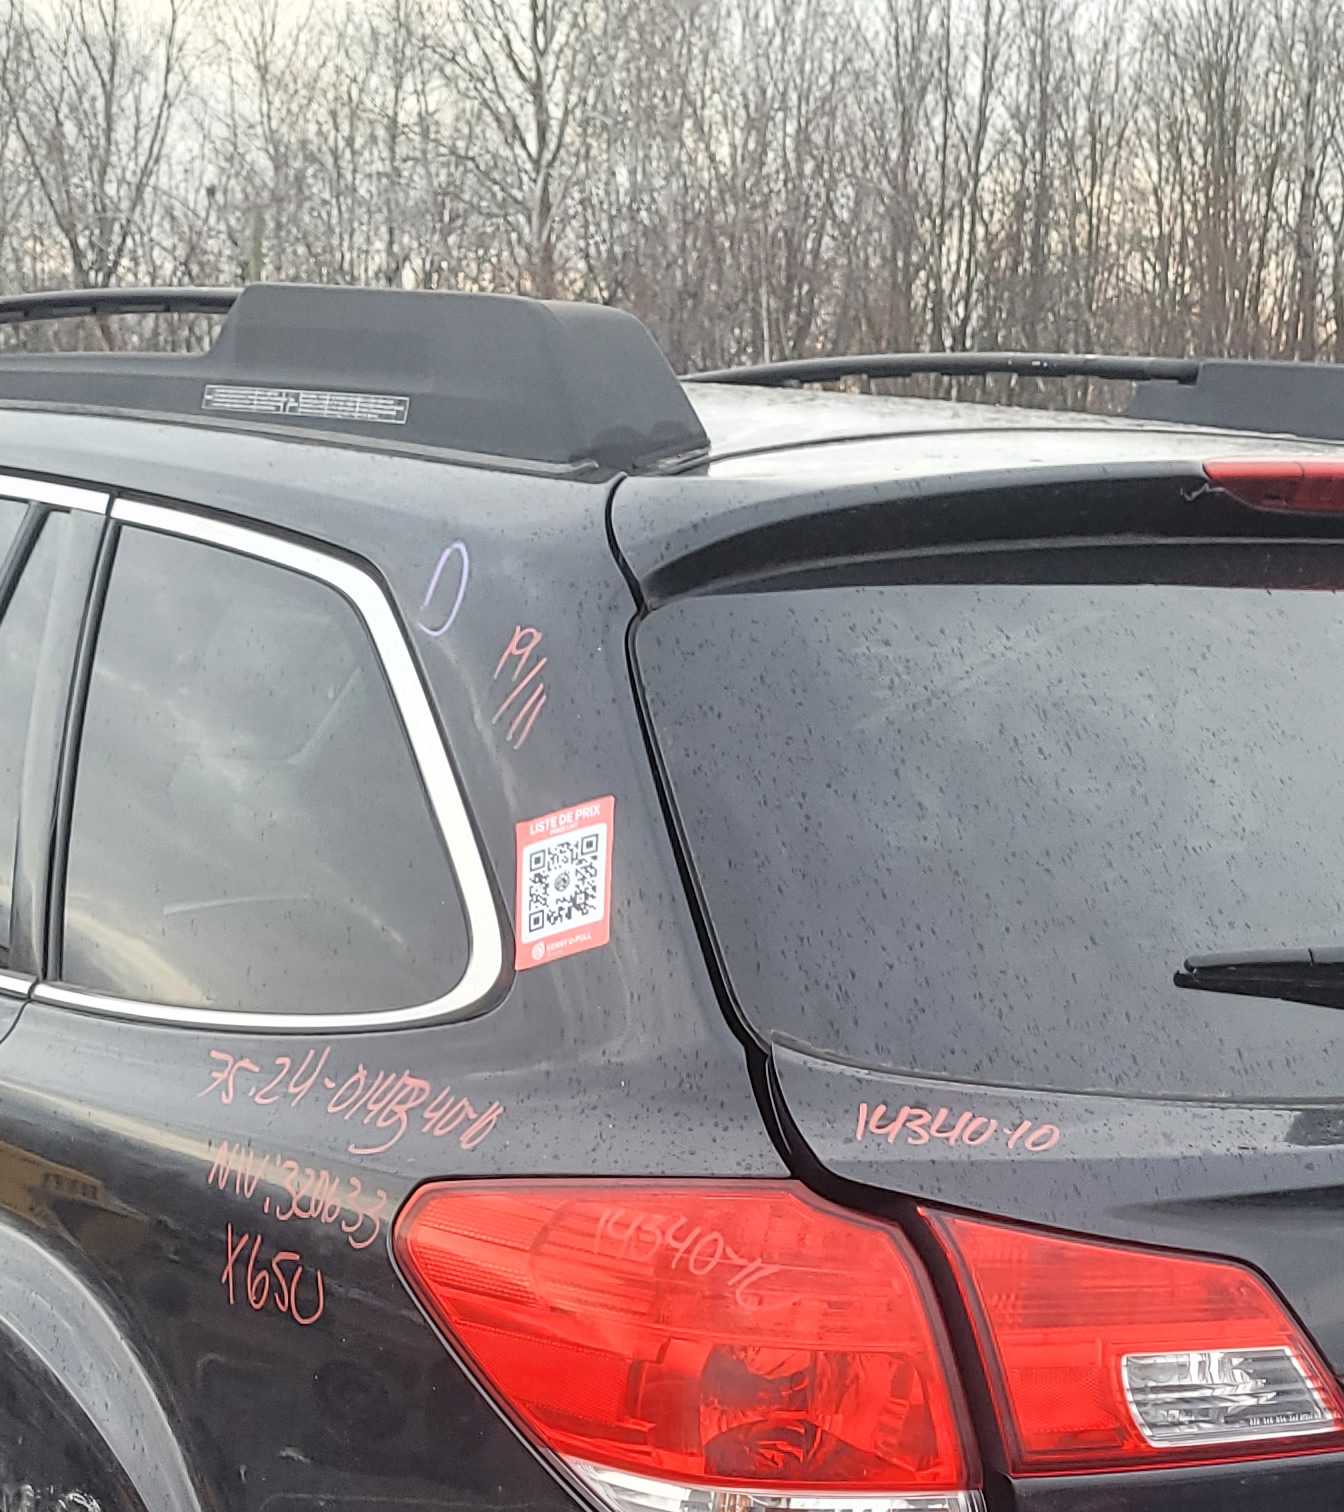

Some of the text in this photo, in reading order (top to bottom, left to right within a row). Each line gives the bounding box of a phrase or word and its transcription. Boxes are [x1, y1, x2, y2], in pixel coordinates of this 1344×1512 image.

[528, 803, 601, 836] LISTE DE PRIX
